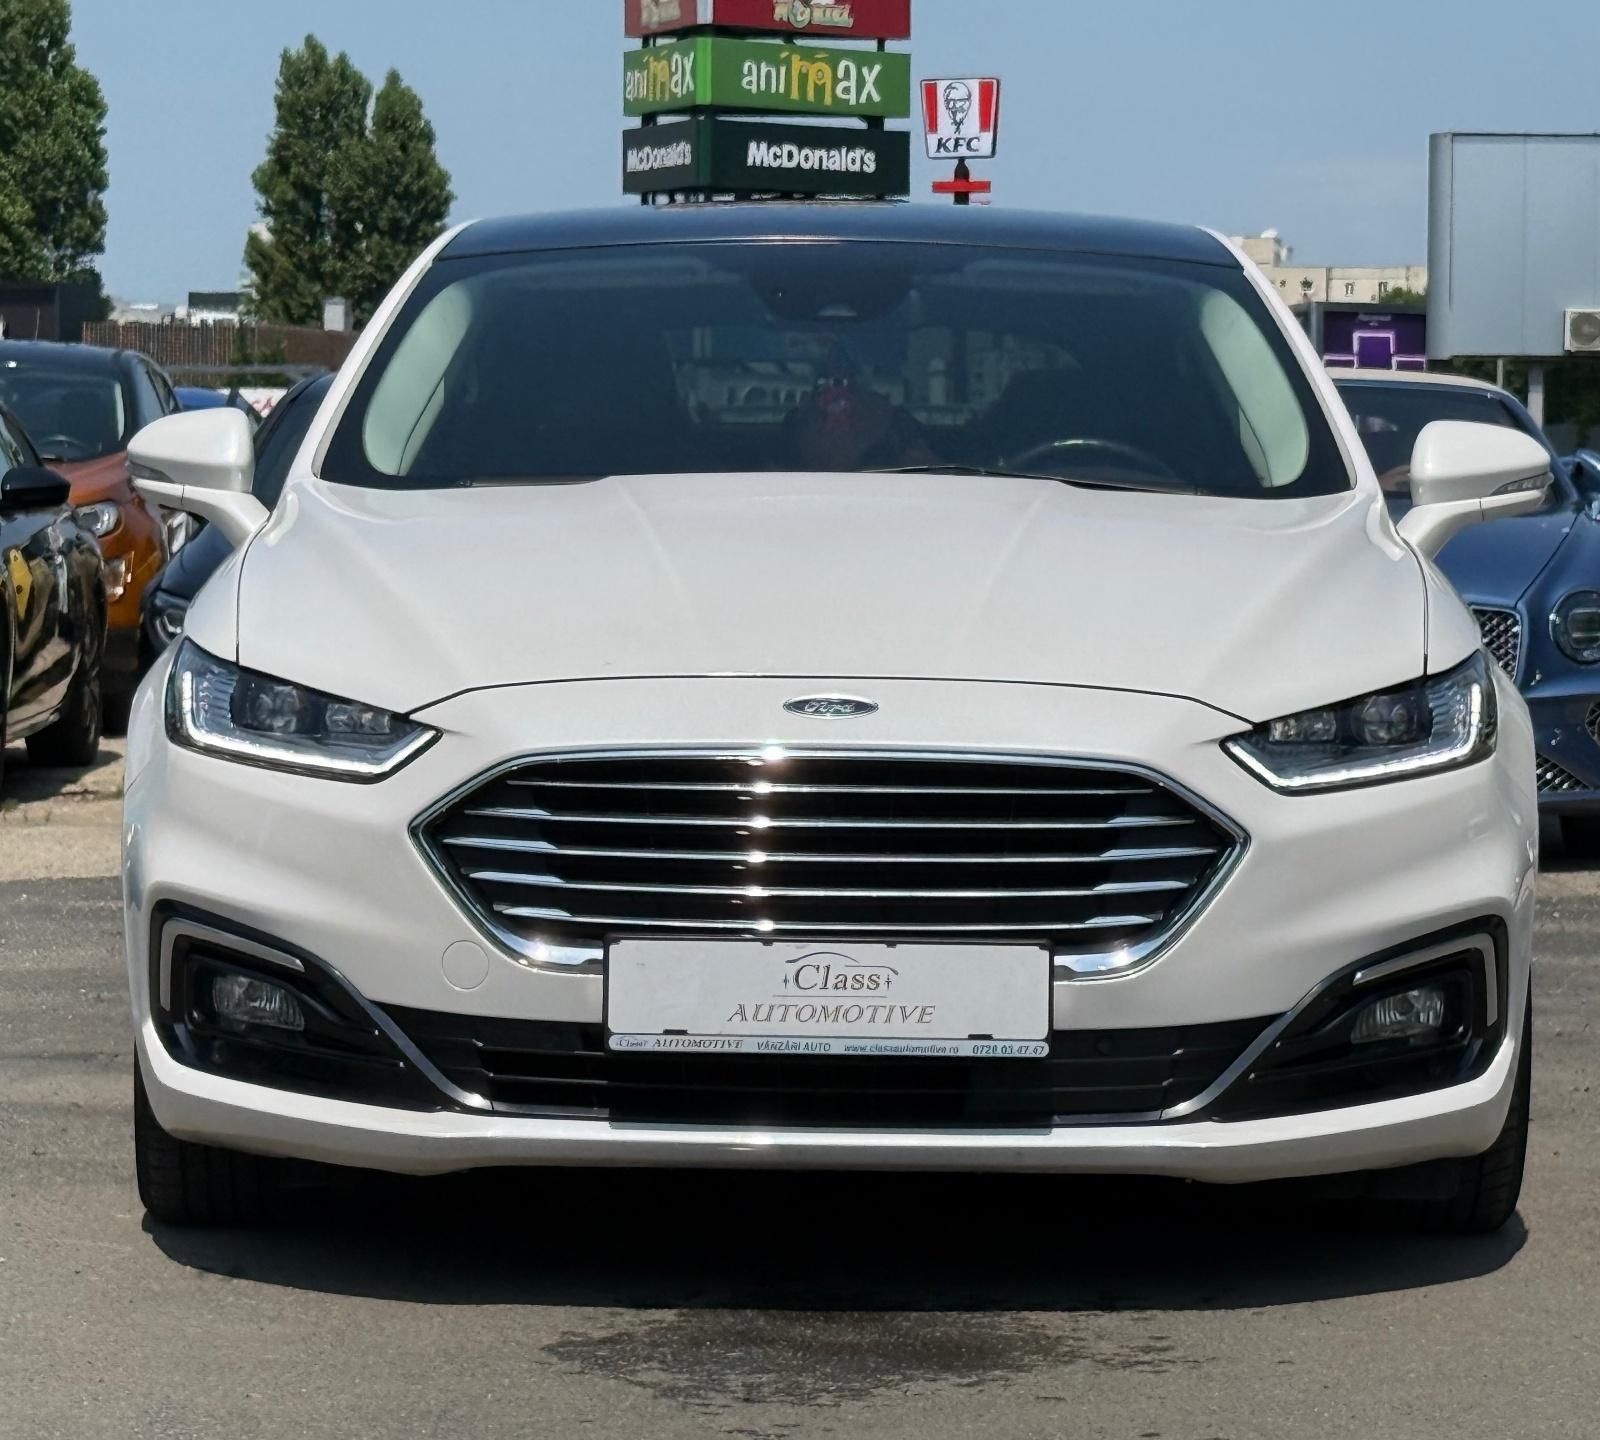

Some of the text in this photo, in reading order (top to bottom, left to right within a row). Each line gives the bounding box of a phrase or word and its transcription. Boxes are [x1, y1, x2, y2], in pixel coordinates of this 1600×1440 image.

[741, 51, 882, 106] animax
[626, 140, 692, 172] McDonald's
[746, 140, 877, 174] McDonald's
[935, 136, 981, 154] KFC
[804, 701, 856, 713] Ford
[793, 963, 881, 991] Class
[727, 1003, 936, 1025] AUTOMOTIVE
[802, 1041, 832, 1053] AUTO
